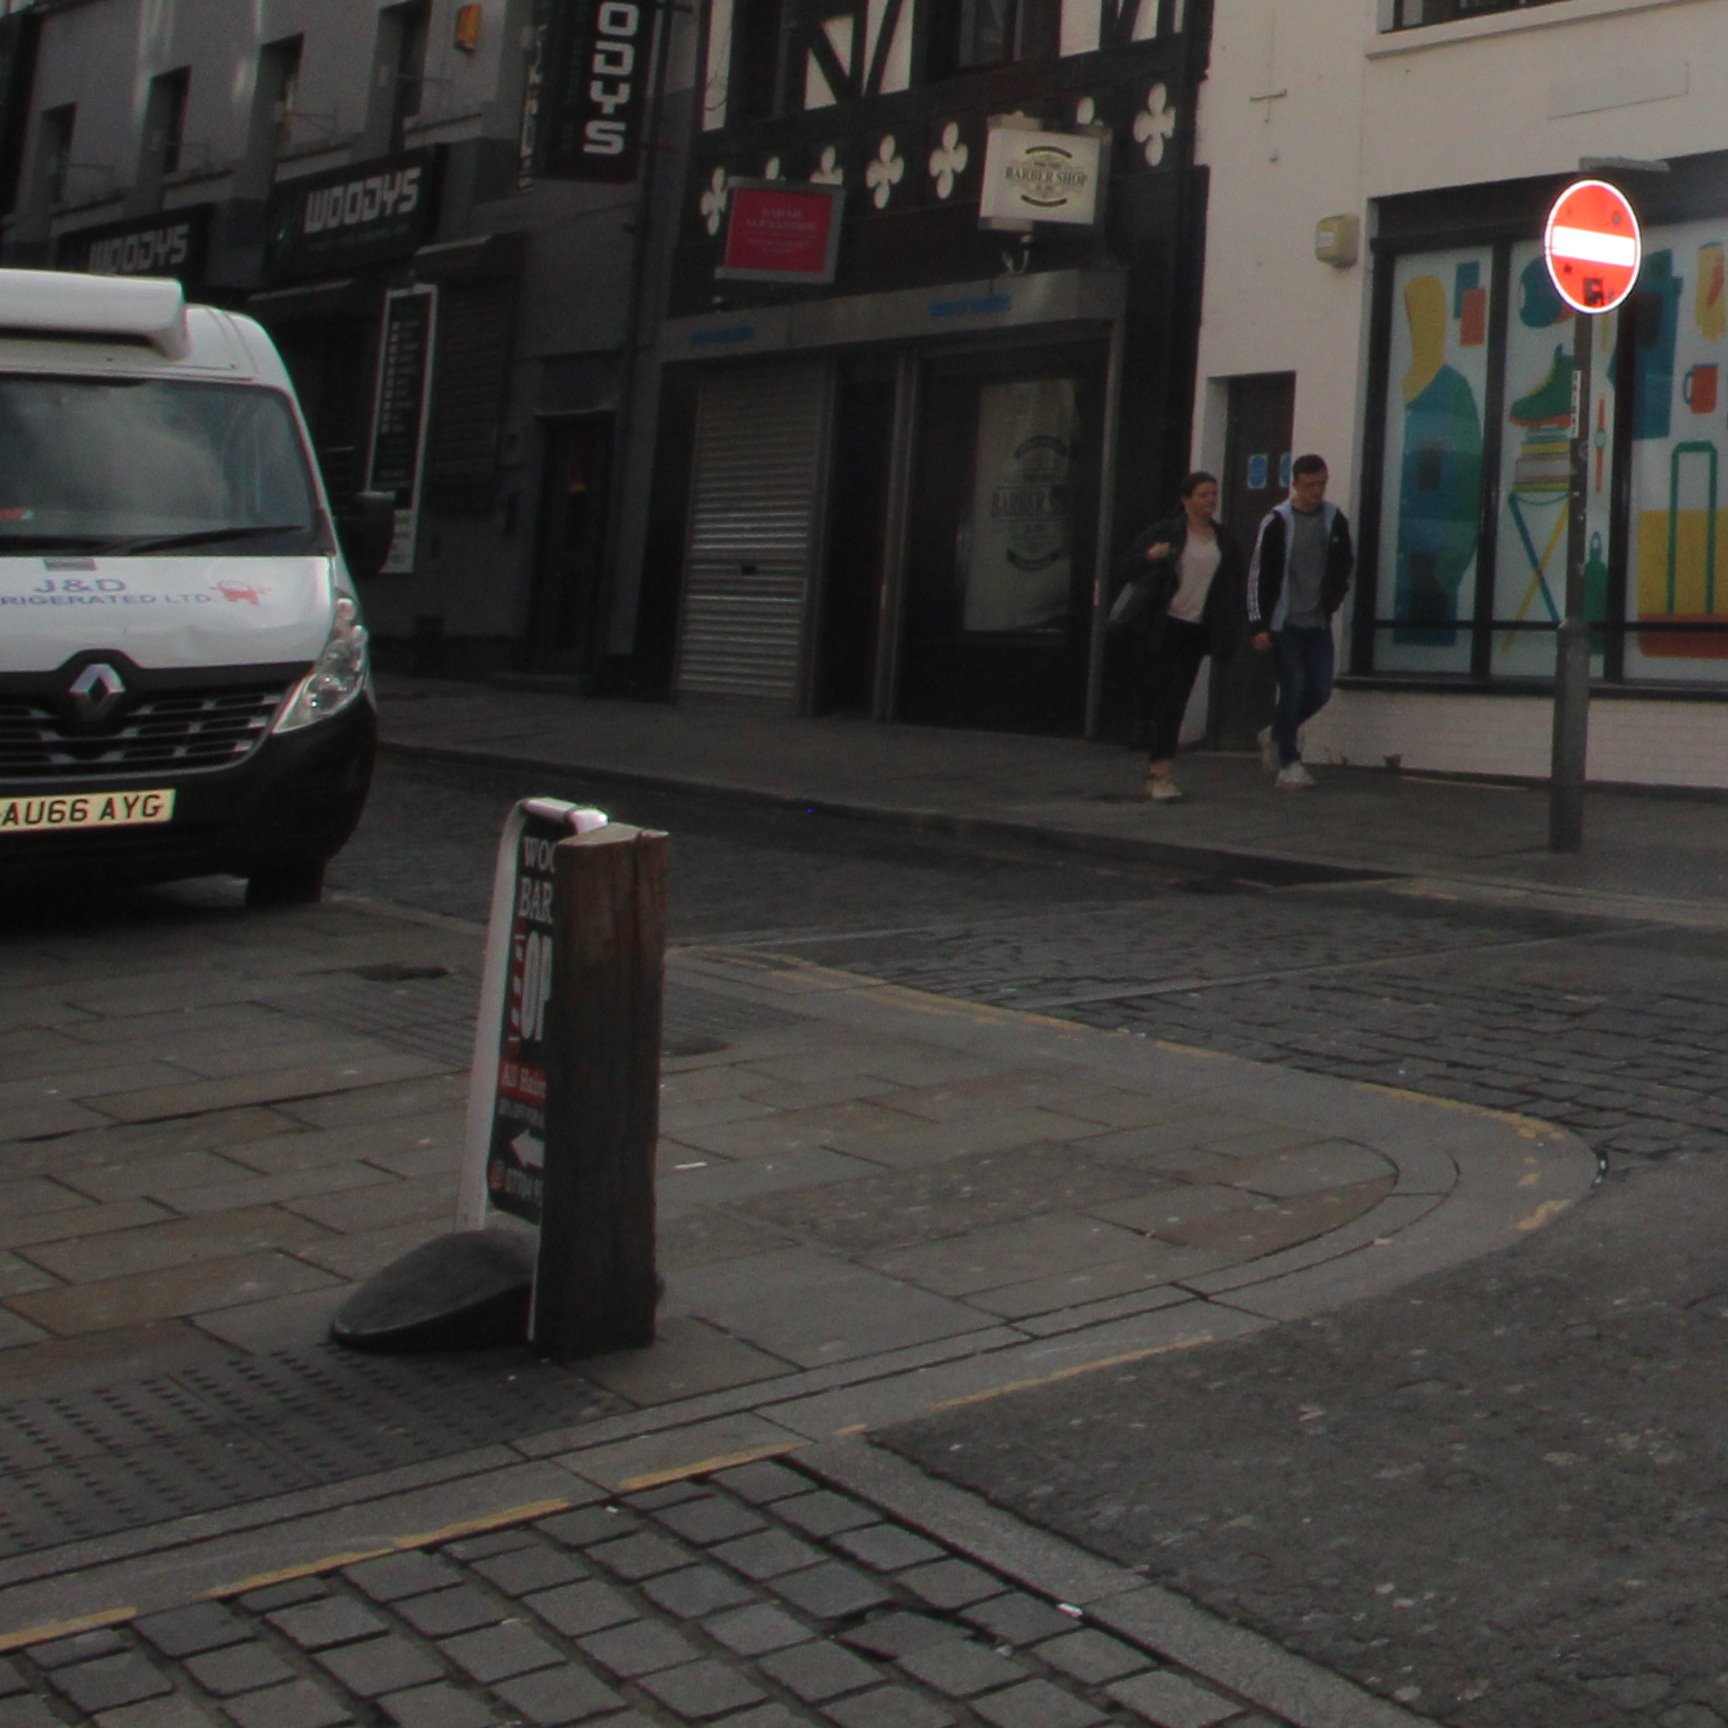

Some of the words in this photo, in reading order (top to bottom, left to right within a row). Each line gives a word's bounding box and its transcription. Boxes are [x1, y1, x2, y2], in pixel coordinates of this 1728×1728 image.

[303, 166, 422, 235] WOODYS
[34, 577, 128, 593] J&D
[2, 797, 91, 826] AU66
[98, 793, 165, 821] AYG
